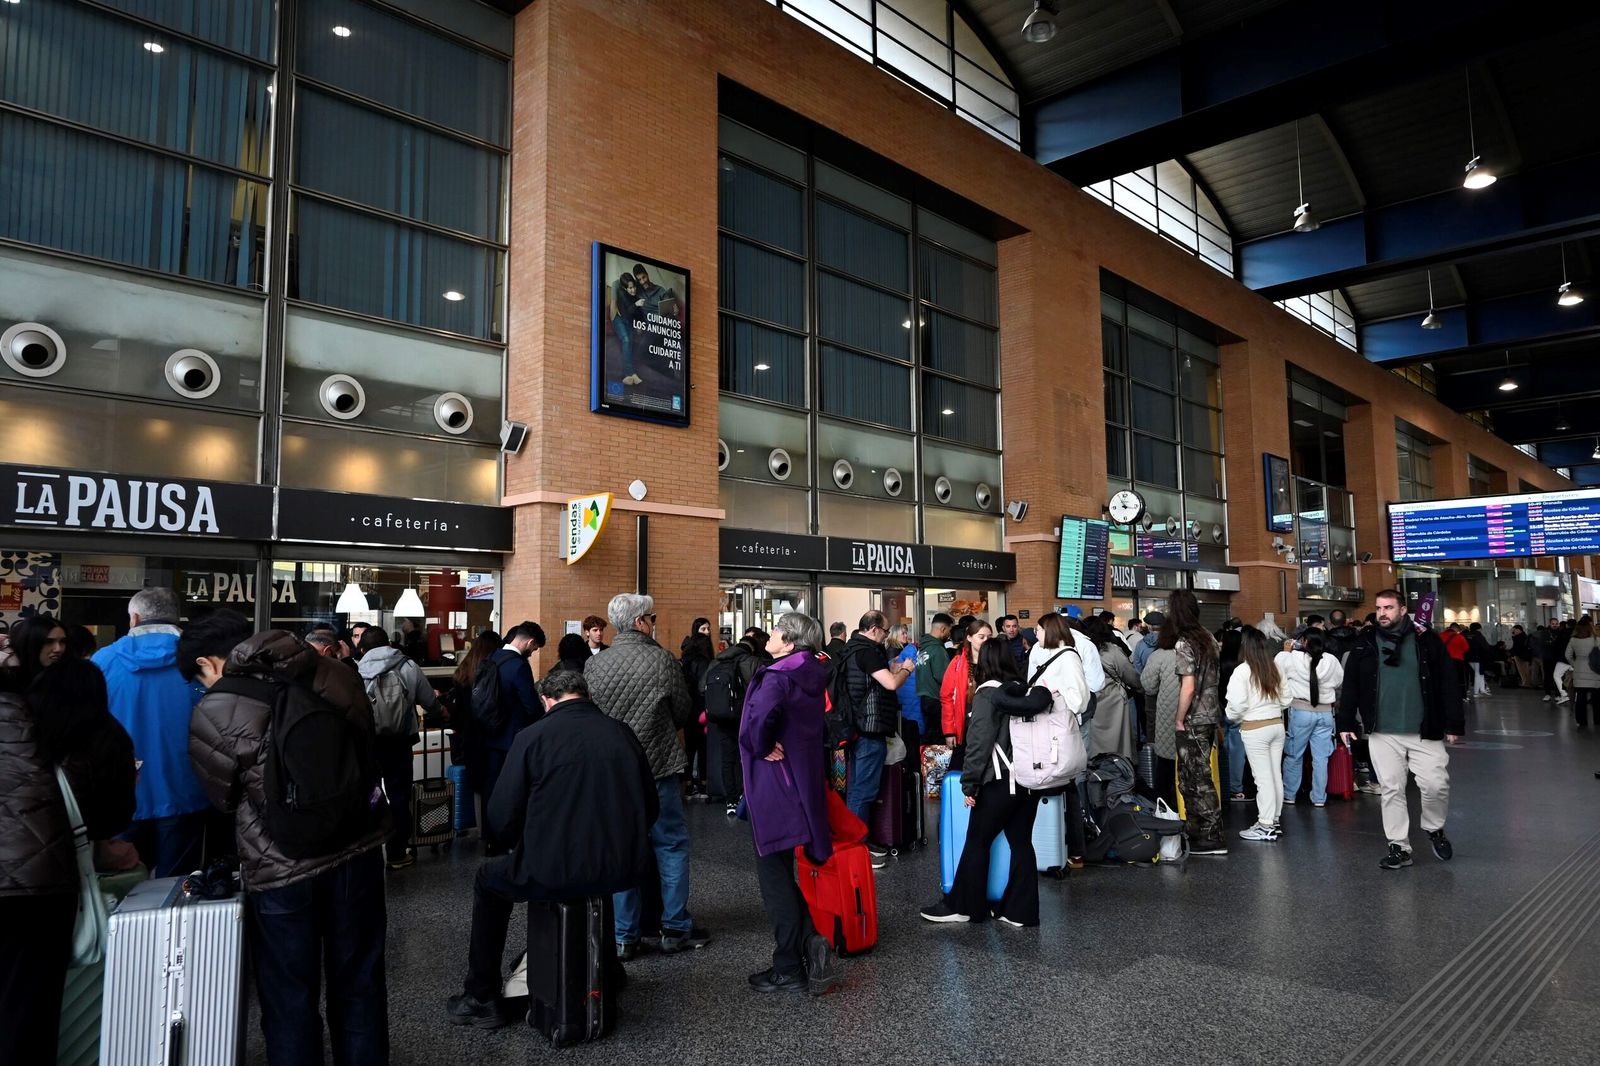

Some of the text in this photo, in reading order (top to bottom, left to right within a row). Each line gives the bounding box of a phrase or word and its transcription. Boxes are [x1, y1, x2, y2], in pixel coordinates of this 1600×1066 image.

[632, 320, 682, 340] LOS ANUNCIOS
[646, 312, 682, 330] CUIDAMOS
[648, 345, 681, 361] CUIDARTE
[664, 338, 681, 350] PARA
[668, 360, 681, 371] A TI
[15, 475, 219, 533] LA PAUSA
[362, 513, 448, 532] cafetería
[570, 503, 578, 555] tiendas
[852, 543, 916, 574] LA PAUSA
[186, 577, 208, 596] LA
